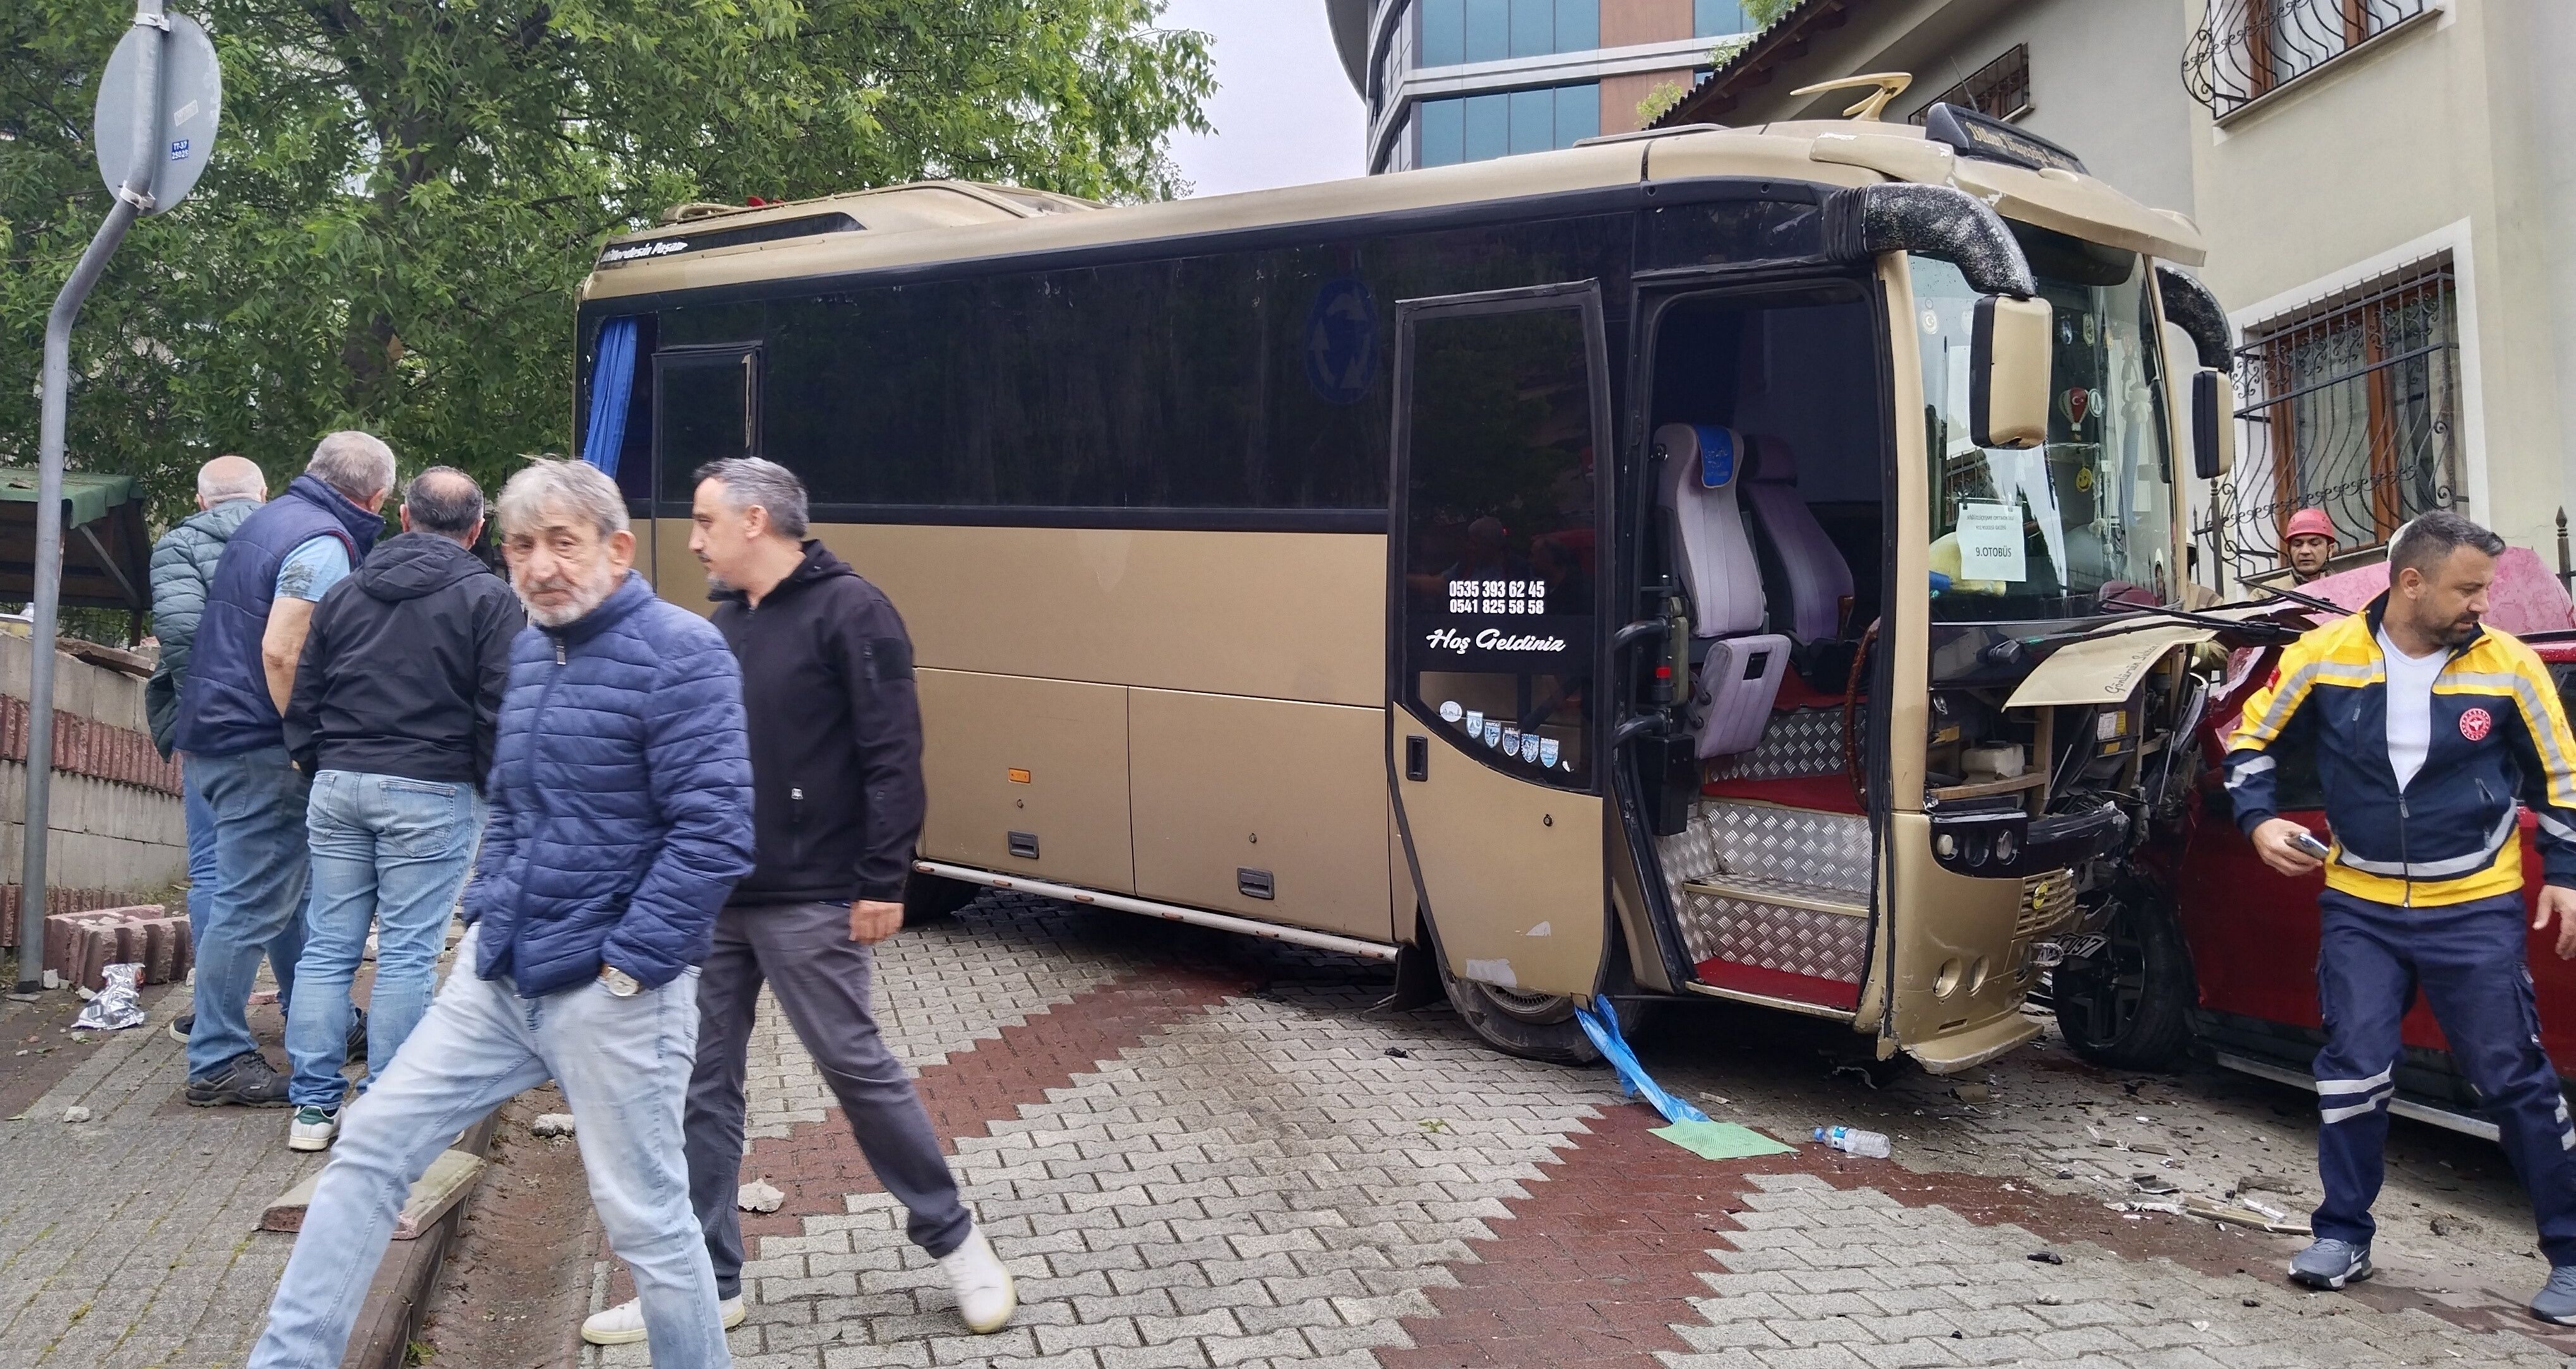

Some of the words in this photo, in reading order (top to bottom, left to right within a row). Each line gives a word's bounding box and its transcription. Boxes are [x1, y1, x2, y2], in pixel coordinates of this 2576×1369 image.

[1976, 545, 2012, 557] 9.OTOBÜS
[1449, 581, 1479, 597] 0535
[1482, 581, 1506, 598] 393
[1508, 581, 1525, 598] 62
[1528, 581, 1545, 598] 45
[1450, 599, 1478, 613] 0541
[1482, 599, 1506, 613] 825
[1508, 600, 1525, 614] 58
[1527, 600, 1544, 614] 58
[1426, 628, 1471, 655] Hoş
[1476, 628, 1566, 651] Geldiniz
